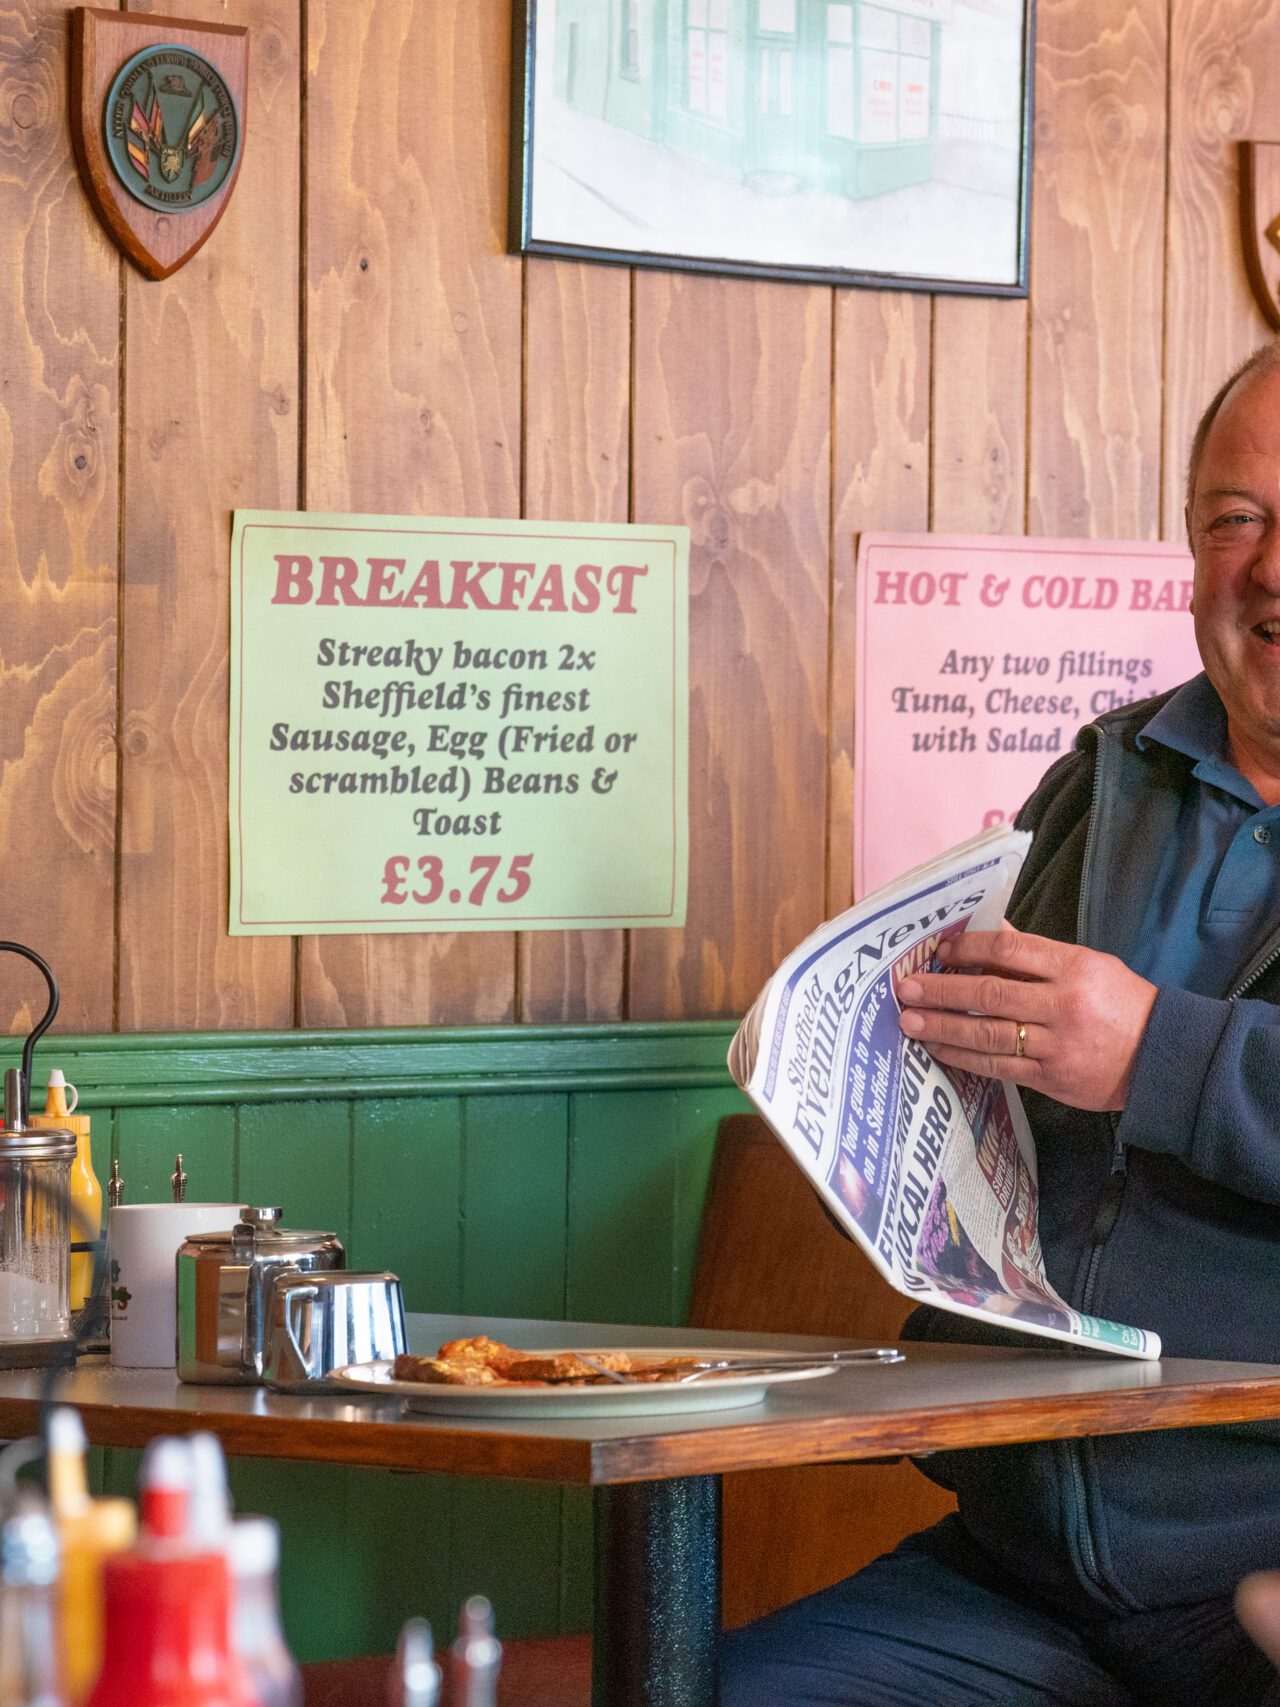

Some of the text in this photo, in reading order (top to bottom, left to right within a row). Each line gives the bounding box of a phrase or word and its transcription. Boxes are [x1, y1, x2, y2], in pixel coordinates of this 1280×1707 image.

[271, 554, 648, 614] BREAKFAST
[874, 571, 968, 606] HOT
[980, 574, 1010, 607] &
[1022, 576, 1119, 610] COLD
[317, 638, 596, 676] Streaky bacon 2x
[939, 650, 1152, 684] Any two fillings
[323, 680, 590, 719] Sheffield's finest
[892, 687, 974, 718] Tuna,
[985, 688, 1080, 719] Cheese,
[270, 723, 637, 760] Sausage, Egg (Fried or
[913, 726, 976, 752] with
[987, 727, 1061, 752] Salad
[289, 765, 619, 802] scrambled) Beans &
[413, 808, 501, 835] Toast
[381, 853, 534, 906] £3.75
[860, 981, 888, 1043] what's
[787, 973, 824, 1096] Sheffield
[854, 1042, 870, 1065] to
[849, 1062, 867, 1121] guide
[841, 1120, 859, 1159] Your
[863, 1133, 879, 1164] in
[863, 1156, 875, 1186] on
[896, 1171, 930, 1270] LOCAL
[913, 1085, 952, 1181] HERO
[993, 1153, 1007, 1195] SUPER
